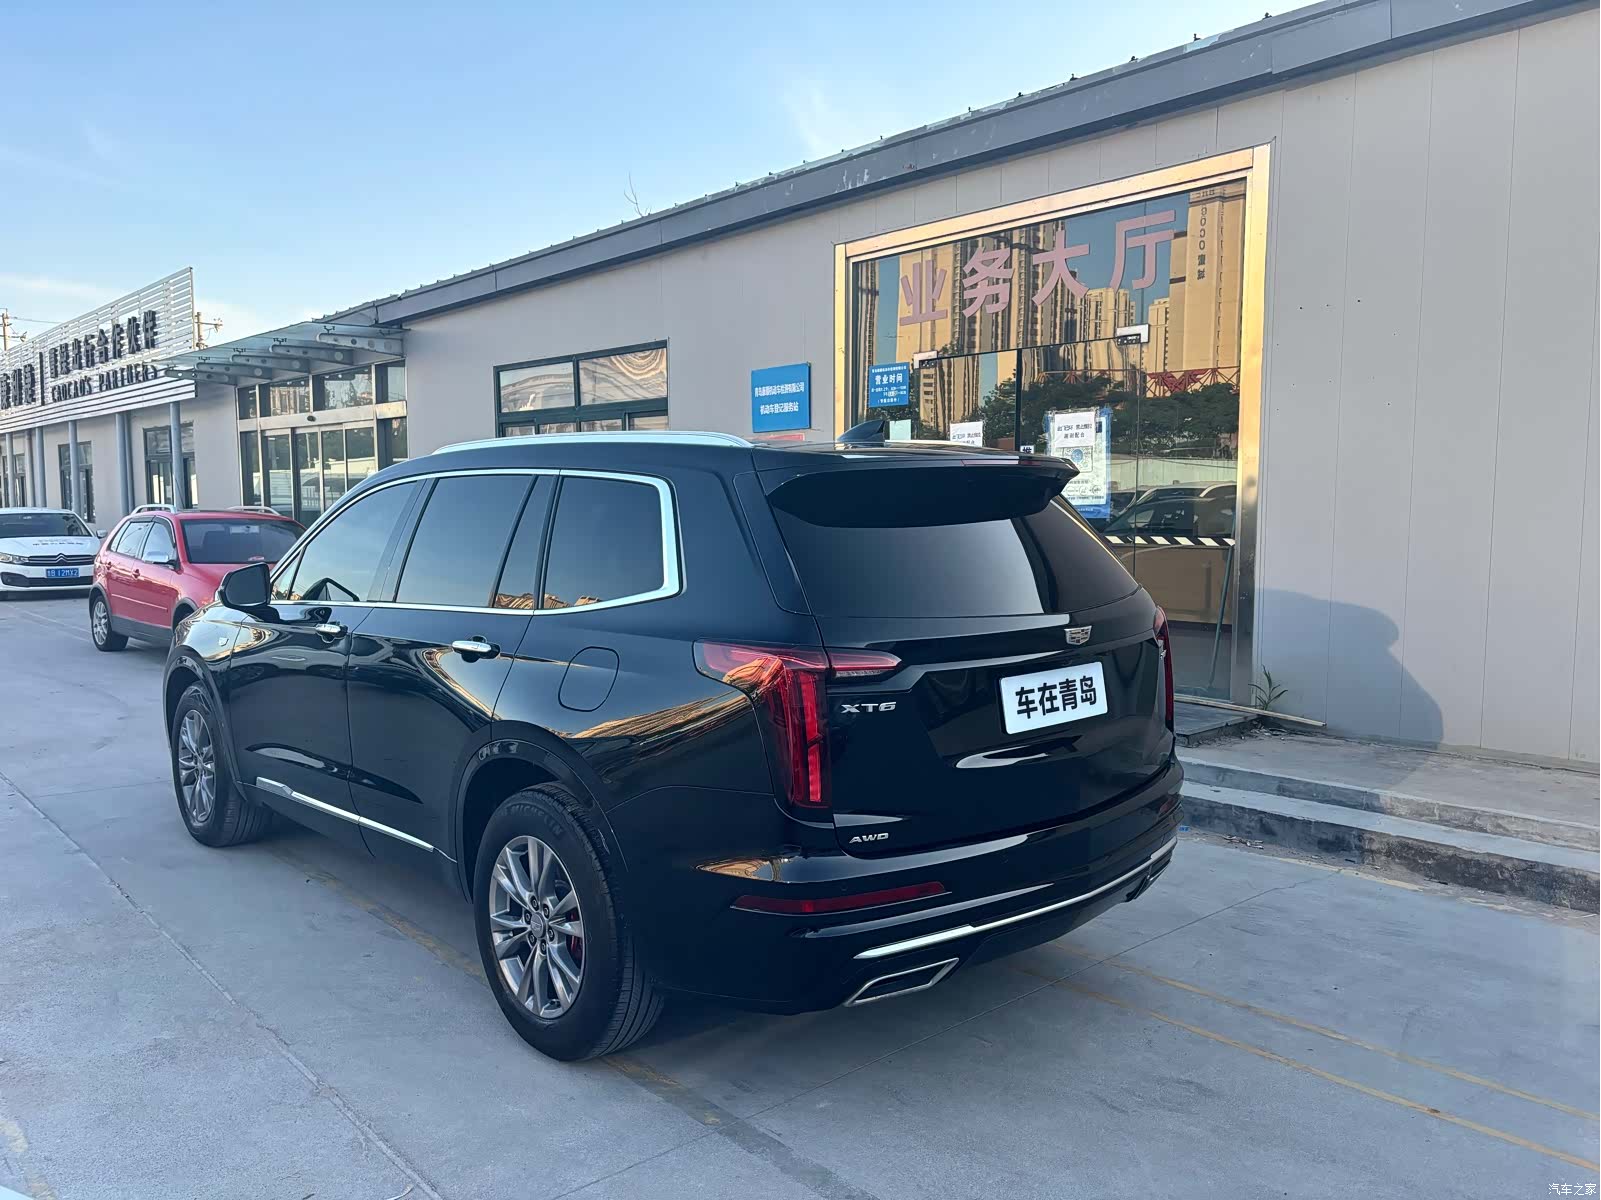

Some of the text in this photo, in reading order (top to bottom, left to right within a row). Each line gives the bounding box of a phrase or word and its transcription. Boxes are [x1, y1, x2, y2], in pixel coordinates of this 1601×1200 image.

[900, 209, 1176, 326] 业务大厅
[875, 373, 903, 385] 营业时间
[1015, 675, 1098, 720] 车在青岛
[840, 701, 897, 714] XT6
[849, 832, 889, 844] AWD
